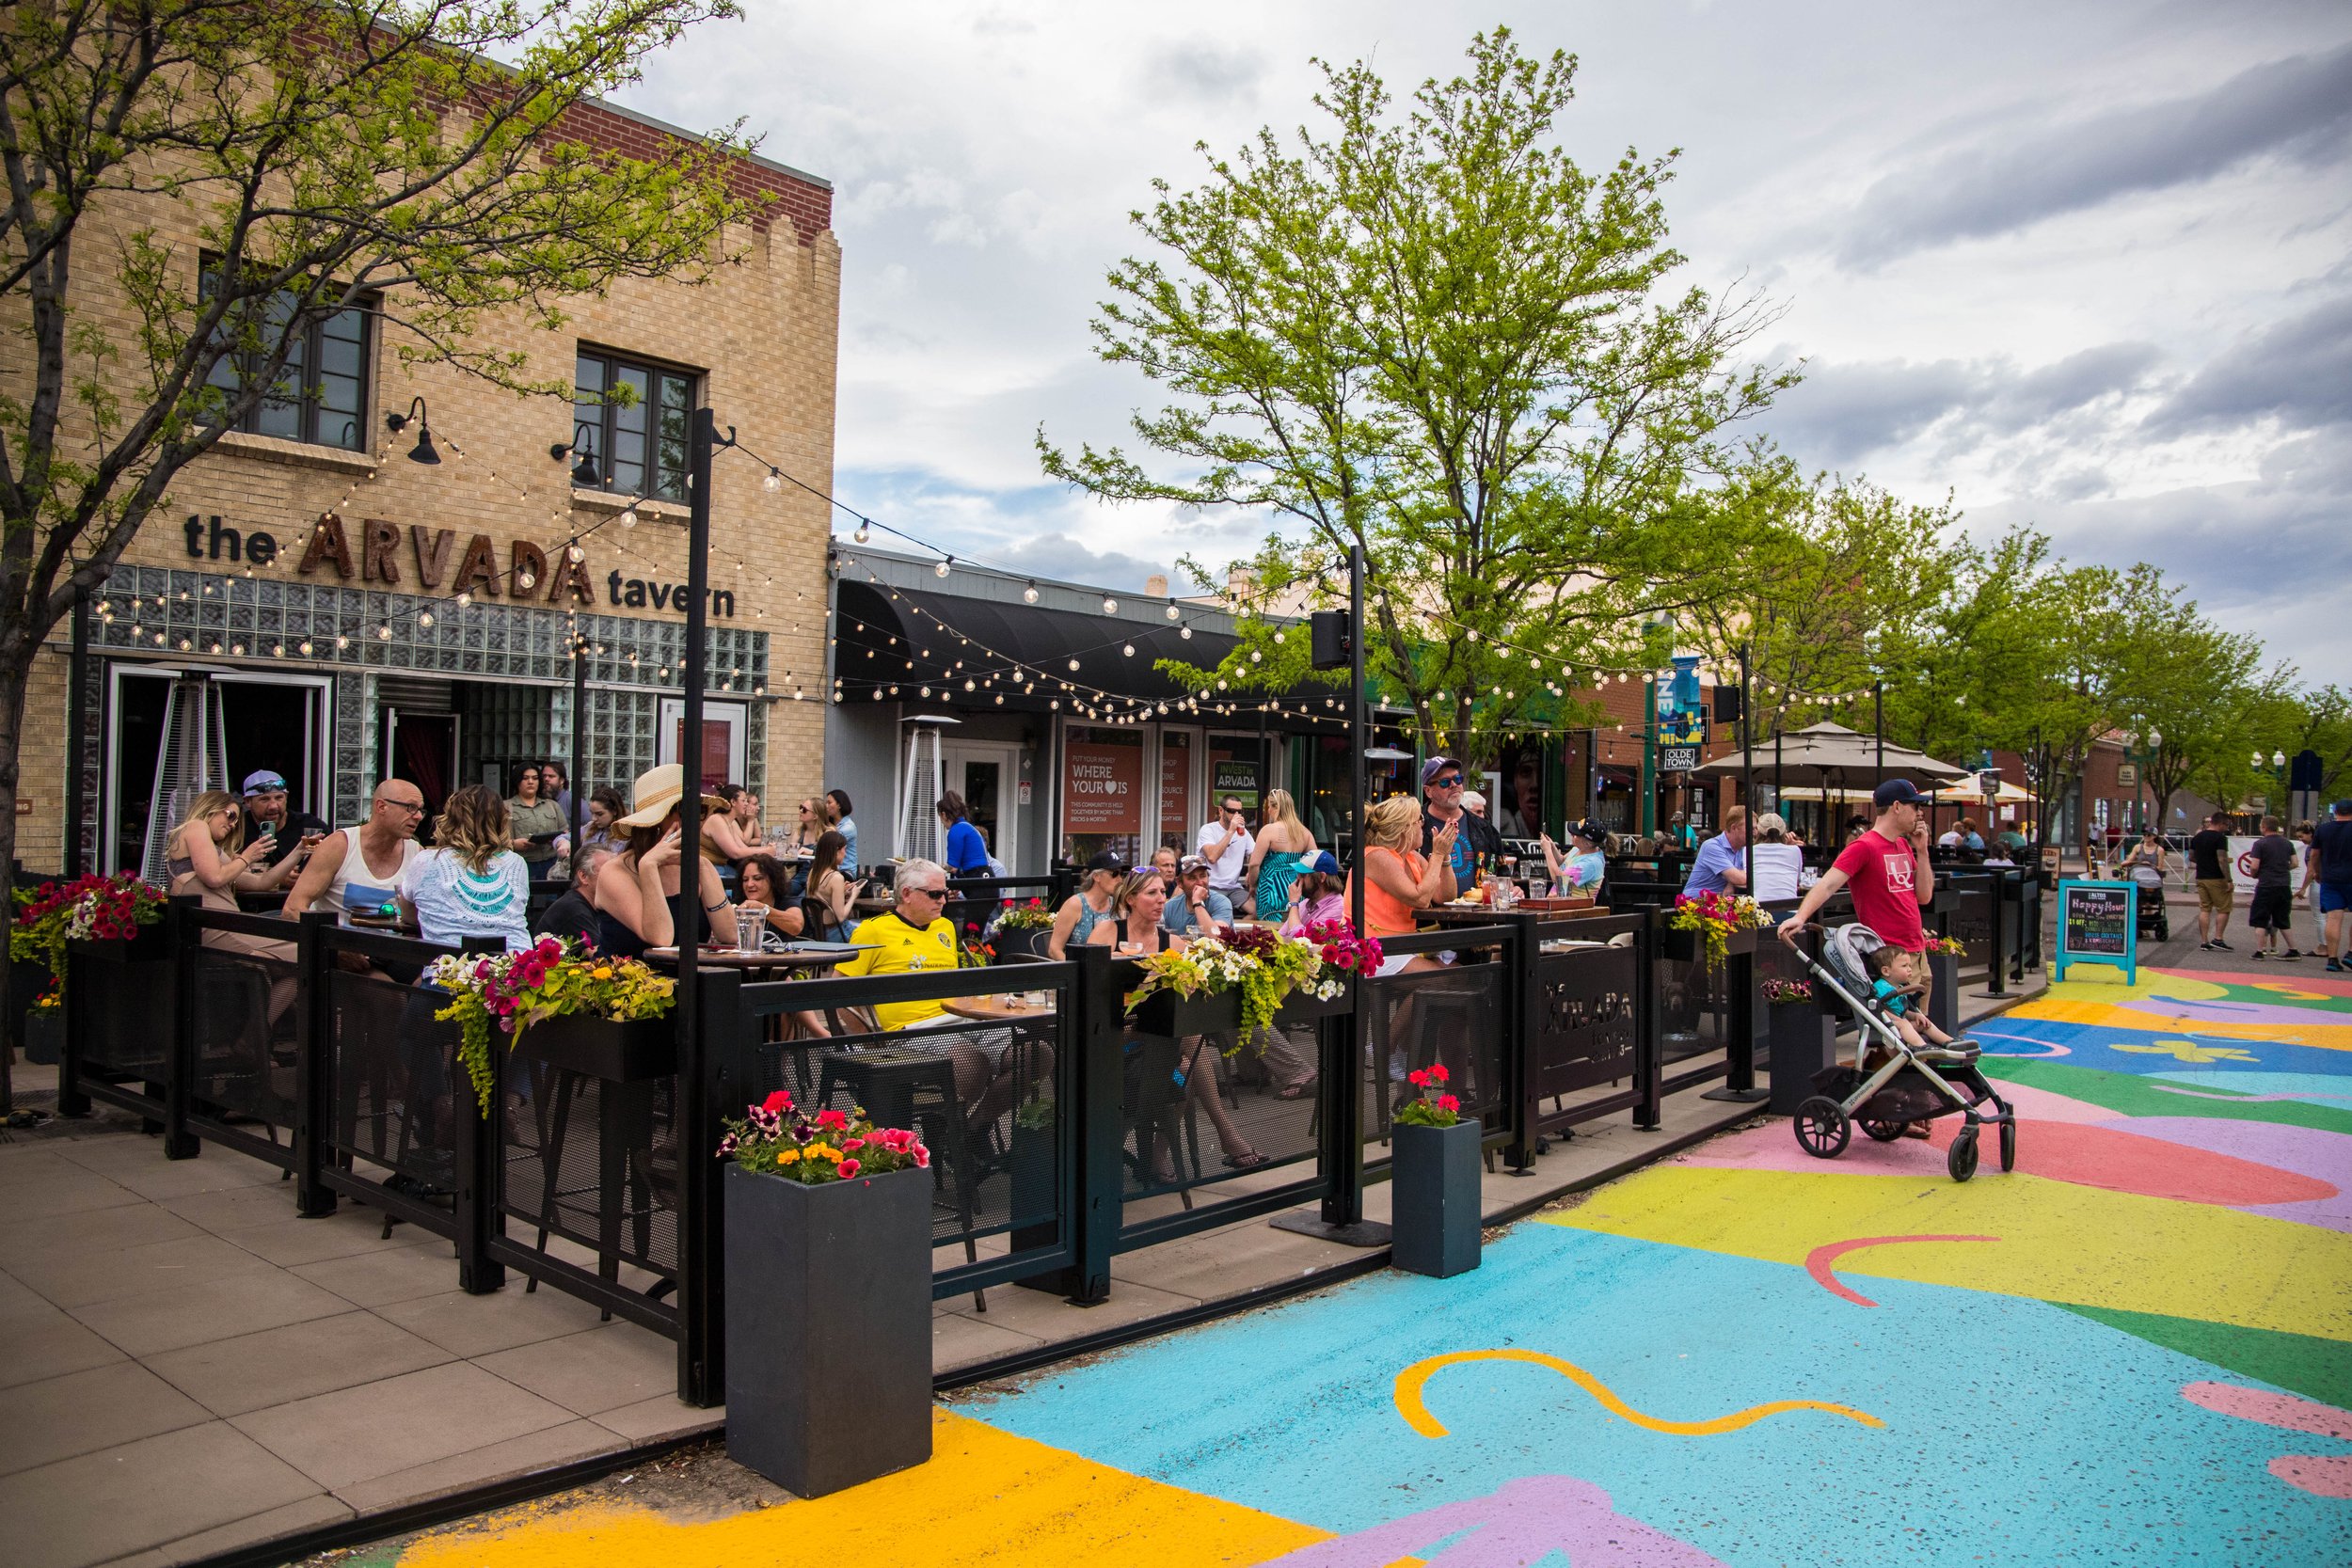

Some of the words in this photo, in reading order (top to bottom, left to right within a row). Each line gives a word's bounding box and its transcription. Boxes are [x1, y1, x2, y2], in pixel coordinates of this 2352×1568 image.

[183, 514, 278, 563] the
[297, 513, 596, 604] ARVADA
[1668, 750, 1692, 758] OLDE
[1666, 758, 1693, 767] TOWN
[1073, 764, 1113, 779] WHERE
[1219, 765, 1247, 775] INVEST
[1217, 775, 1257, 787] ARVADA
[1072, 780, 1104, 794] YOUR
[1118, 782, 1128, 795] IS
[1161, 786, 1184, 795] SOURCE
[1161, 800, 1174, 808] GIVE
[2072, 898, 2105, 915] Happy
[2105, 901, 2125, 911] Hour
